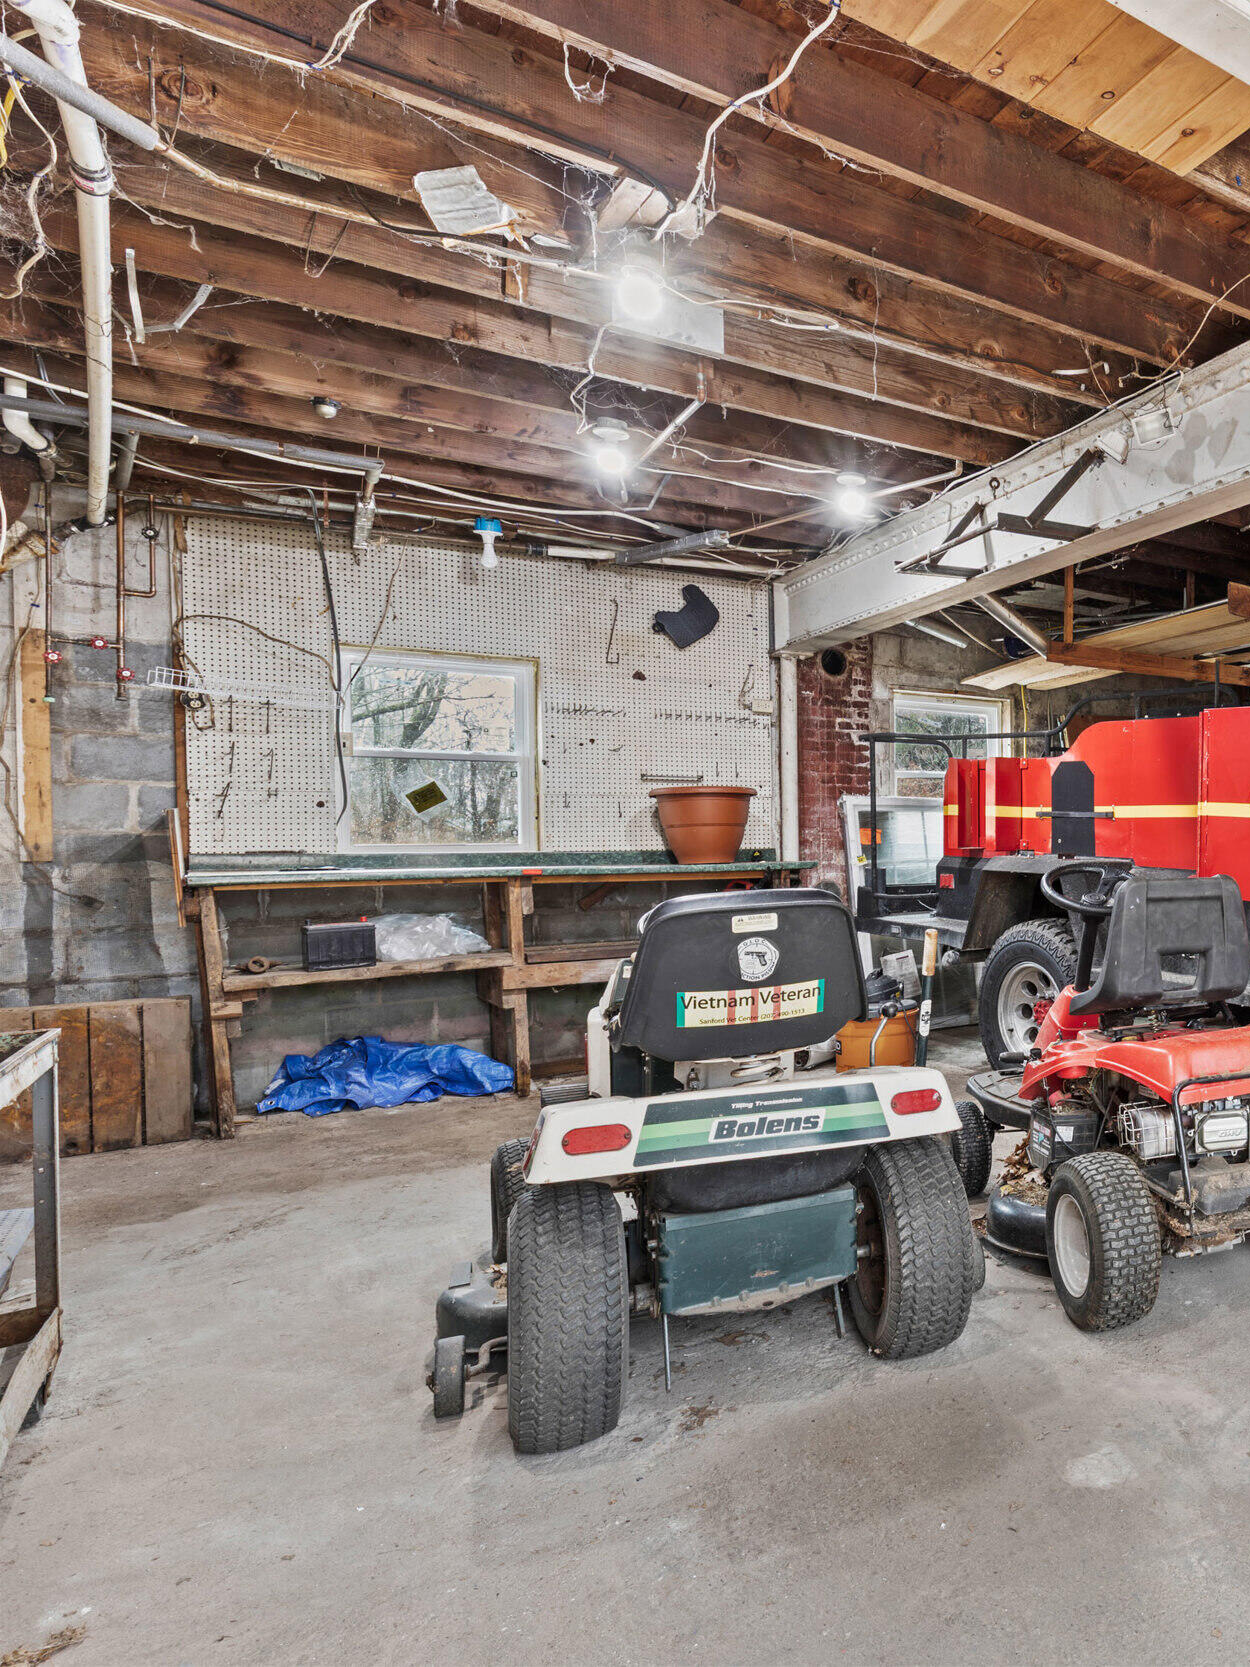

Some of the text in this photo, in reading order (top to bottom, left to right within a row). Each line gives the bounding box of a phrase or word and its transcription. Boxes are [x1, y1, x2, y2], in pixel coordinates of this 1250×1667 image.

[680, 986, 821, 1010] Vietnam Veteran
[738, 1014, 759, 1022] Center
[755, 1097, 803, 1106] Transmission
[713, 1115, 820, 1140] Bolens
